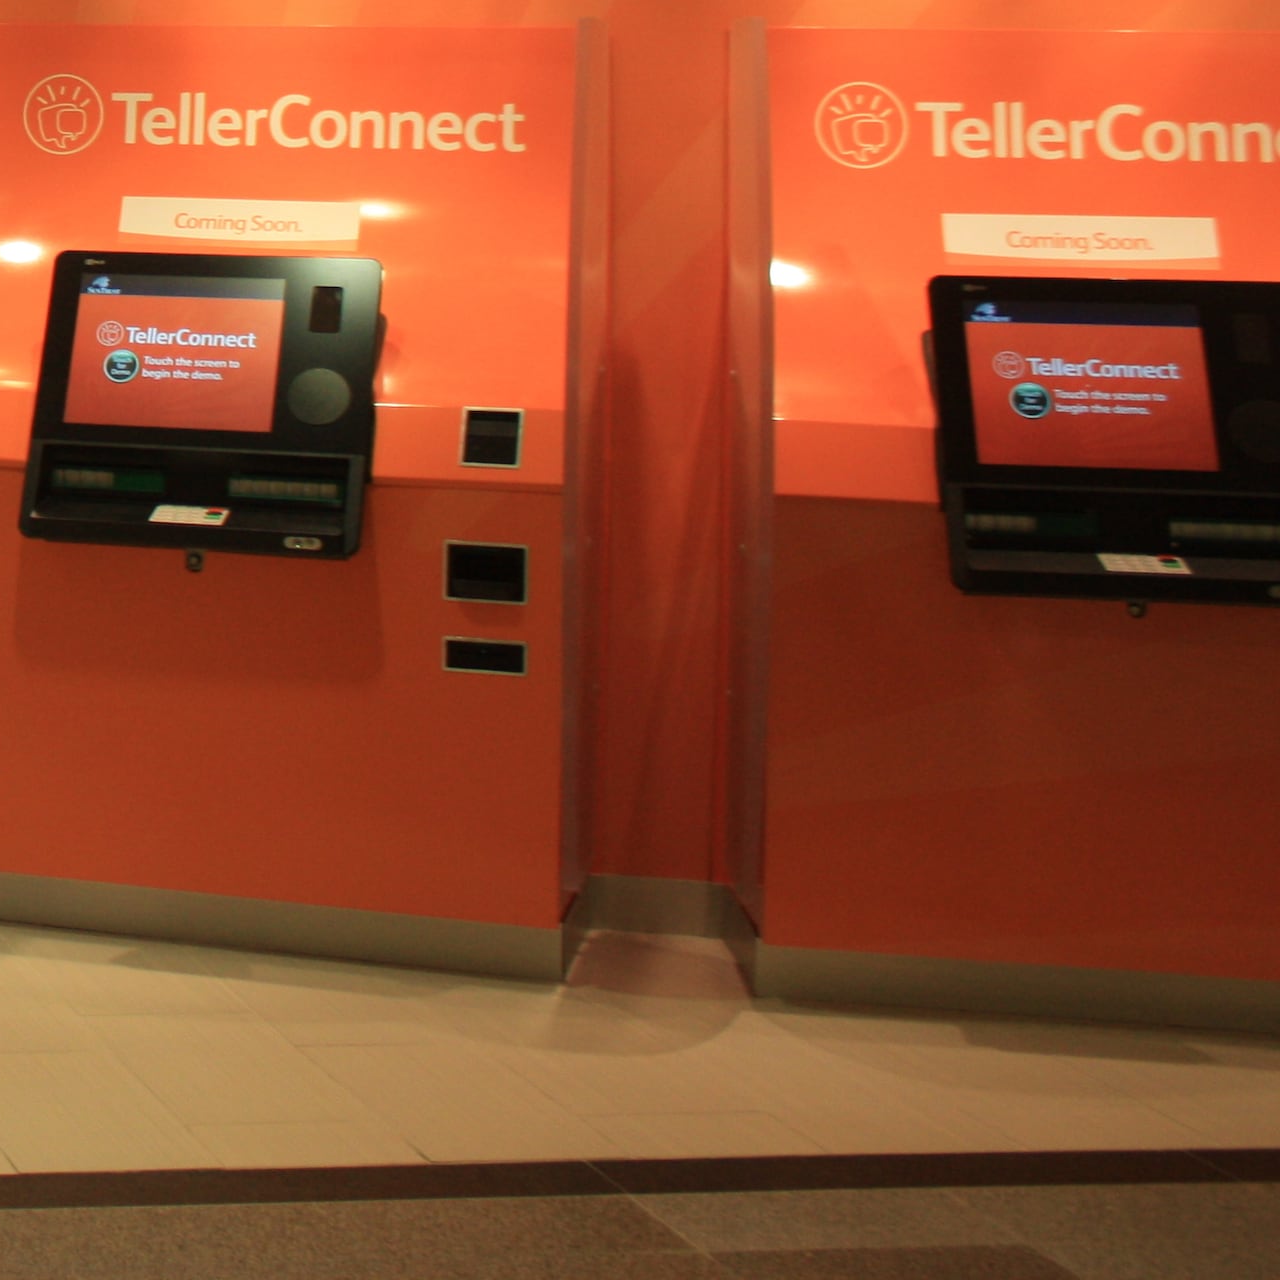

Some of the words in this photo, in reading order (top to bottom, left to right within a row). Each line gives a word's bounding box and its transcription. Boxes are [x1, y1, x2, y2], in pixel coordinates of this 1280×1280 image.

[111, 92, 527, 152] TellerConnect
[915, 101, 1280, 163] TellerConn
[174, 212, 246, 235] Coming
[250, 215, 303, 233] Soon.
[1005, 230, 1088, 254] Coming
[1093, 232, 1155, 251] Soon.
[126, 327, 256, 348] TellerConnect
[144, 355, 174, 366] Touch
[175, 357, 193, 367] the
[194, 359, 227, 368] screen
[228, 359, 241, 369] to
[1025, 357, 1182, 380] TellerConnect
[141, 368, 171, 380] begin
[172, 369, 190, 379] the
[191, 370, 223, 381] demo.
[1053, 389, 1089, 400] Touch
